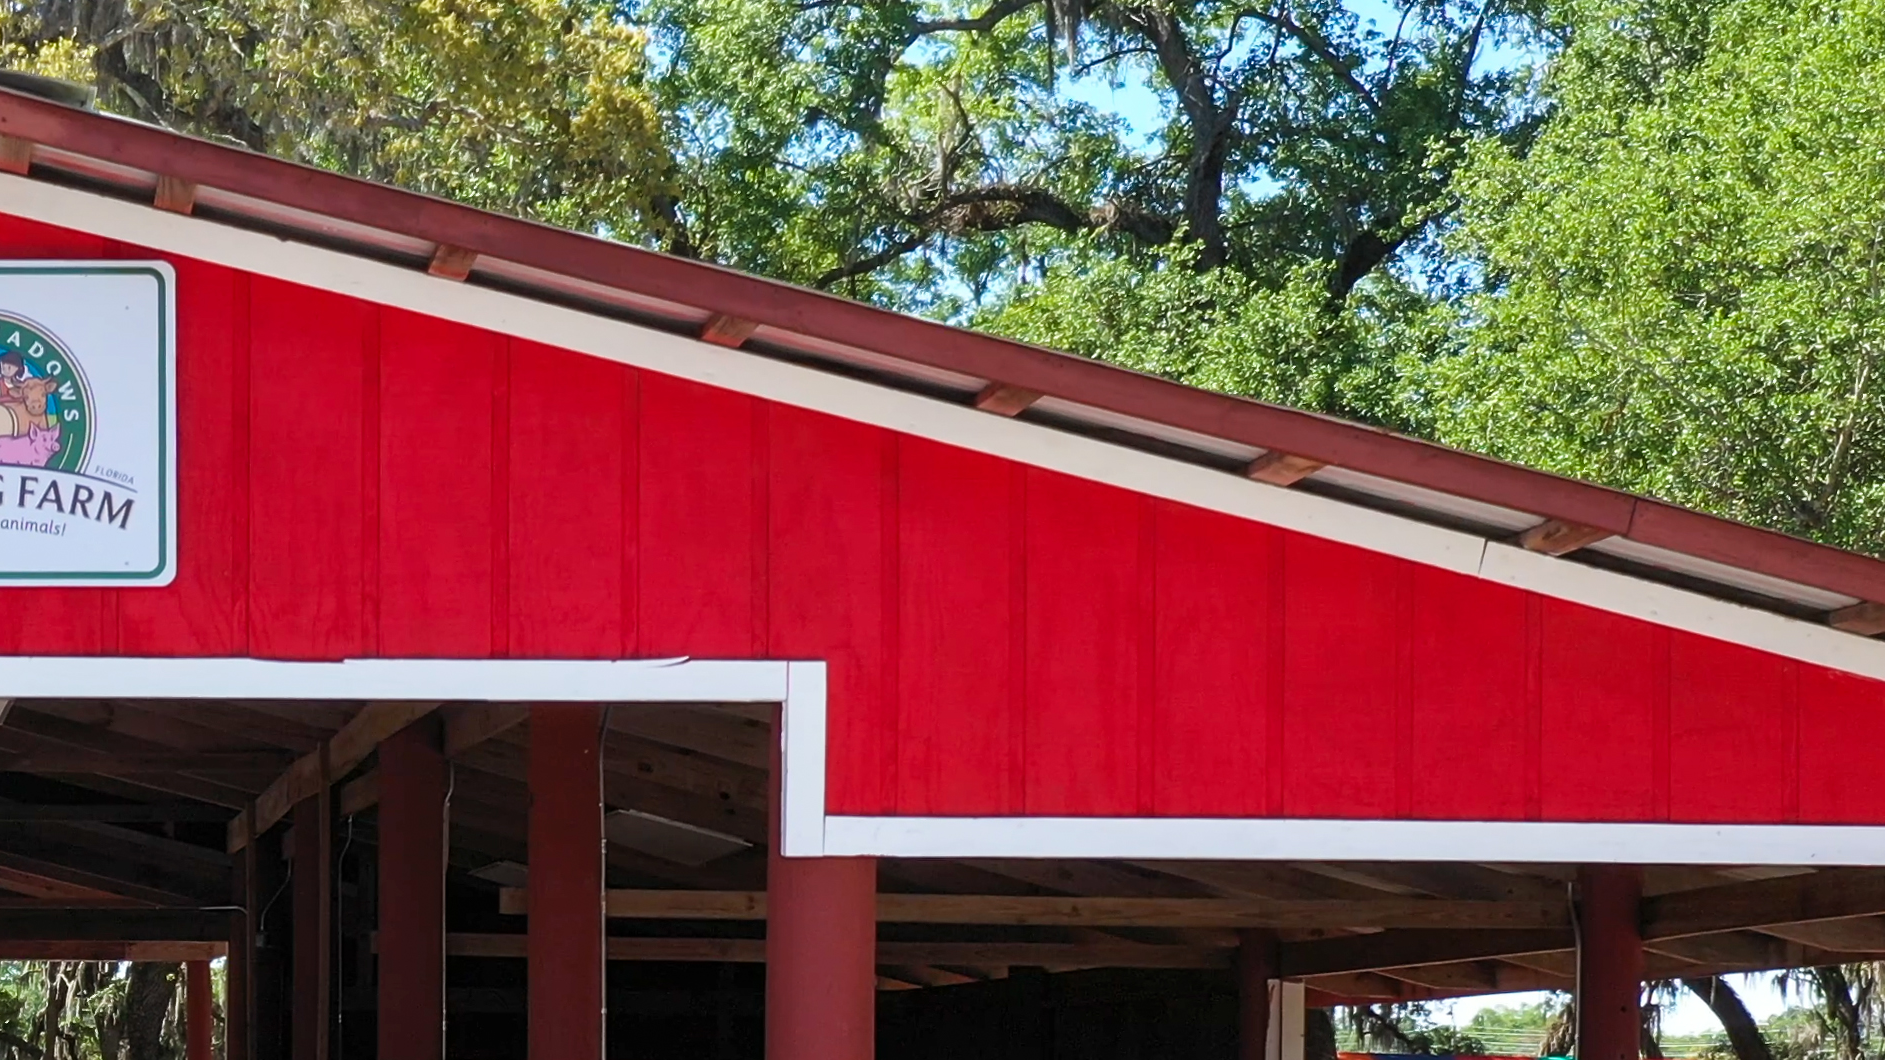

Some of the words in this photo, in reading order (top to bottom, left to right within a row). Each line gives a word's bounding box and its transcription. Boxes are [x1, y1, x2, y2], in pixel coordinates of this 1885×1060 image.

[94, 465, 135, 485] FLORIDA
[17, 475, 135, 531] FARM
[0, 517, 67, 536] animals!
